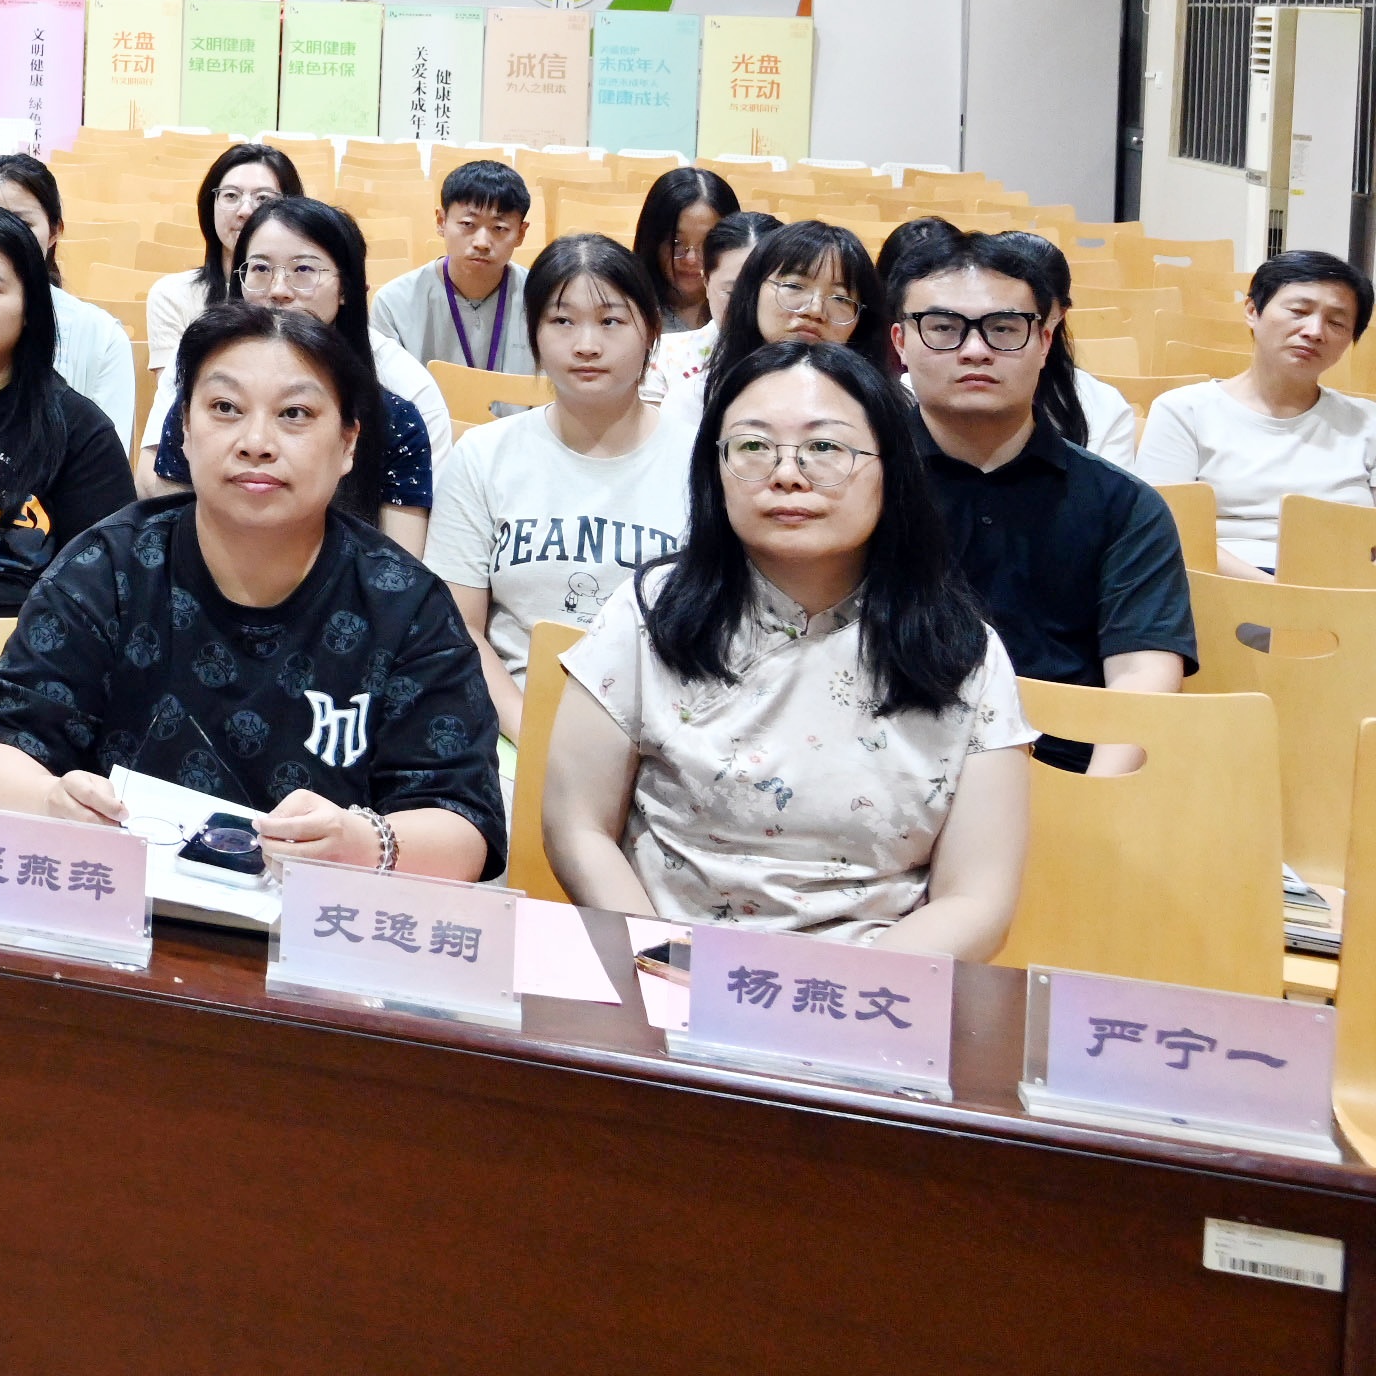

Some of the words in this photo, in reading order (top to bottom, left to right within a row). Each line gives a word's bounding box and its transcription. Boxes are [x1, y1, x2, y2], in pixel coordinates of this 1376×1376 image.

[112, 31, 156, 51] 光盘
[190, 37, 256, 53] 文明健康
[289, 40, 357, 57] 文明健康
[29, 27, 44, 87] 文明健康
[111, 54, 155, 74] 行动
[188, 57, 256, 74] 绿色环保
[506, 53, 567, 80] 诚信
[600, 57, 671, 74] 未成年人
[731, 53, 782, 75] 光盘
[288, 60, 355, 77] 绿色环保
[506, 82, 567, 95] 为人之根本
[598, 88, 672, 107] 健康成长
[730, 78, 781, 100] 行动
[313, 904, 482, 963] 史逸翔
[727, 965, 912, 1029] 杨燕文
[1086, 1016, 1288, 1070] 严宁一
